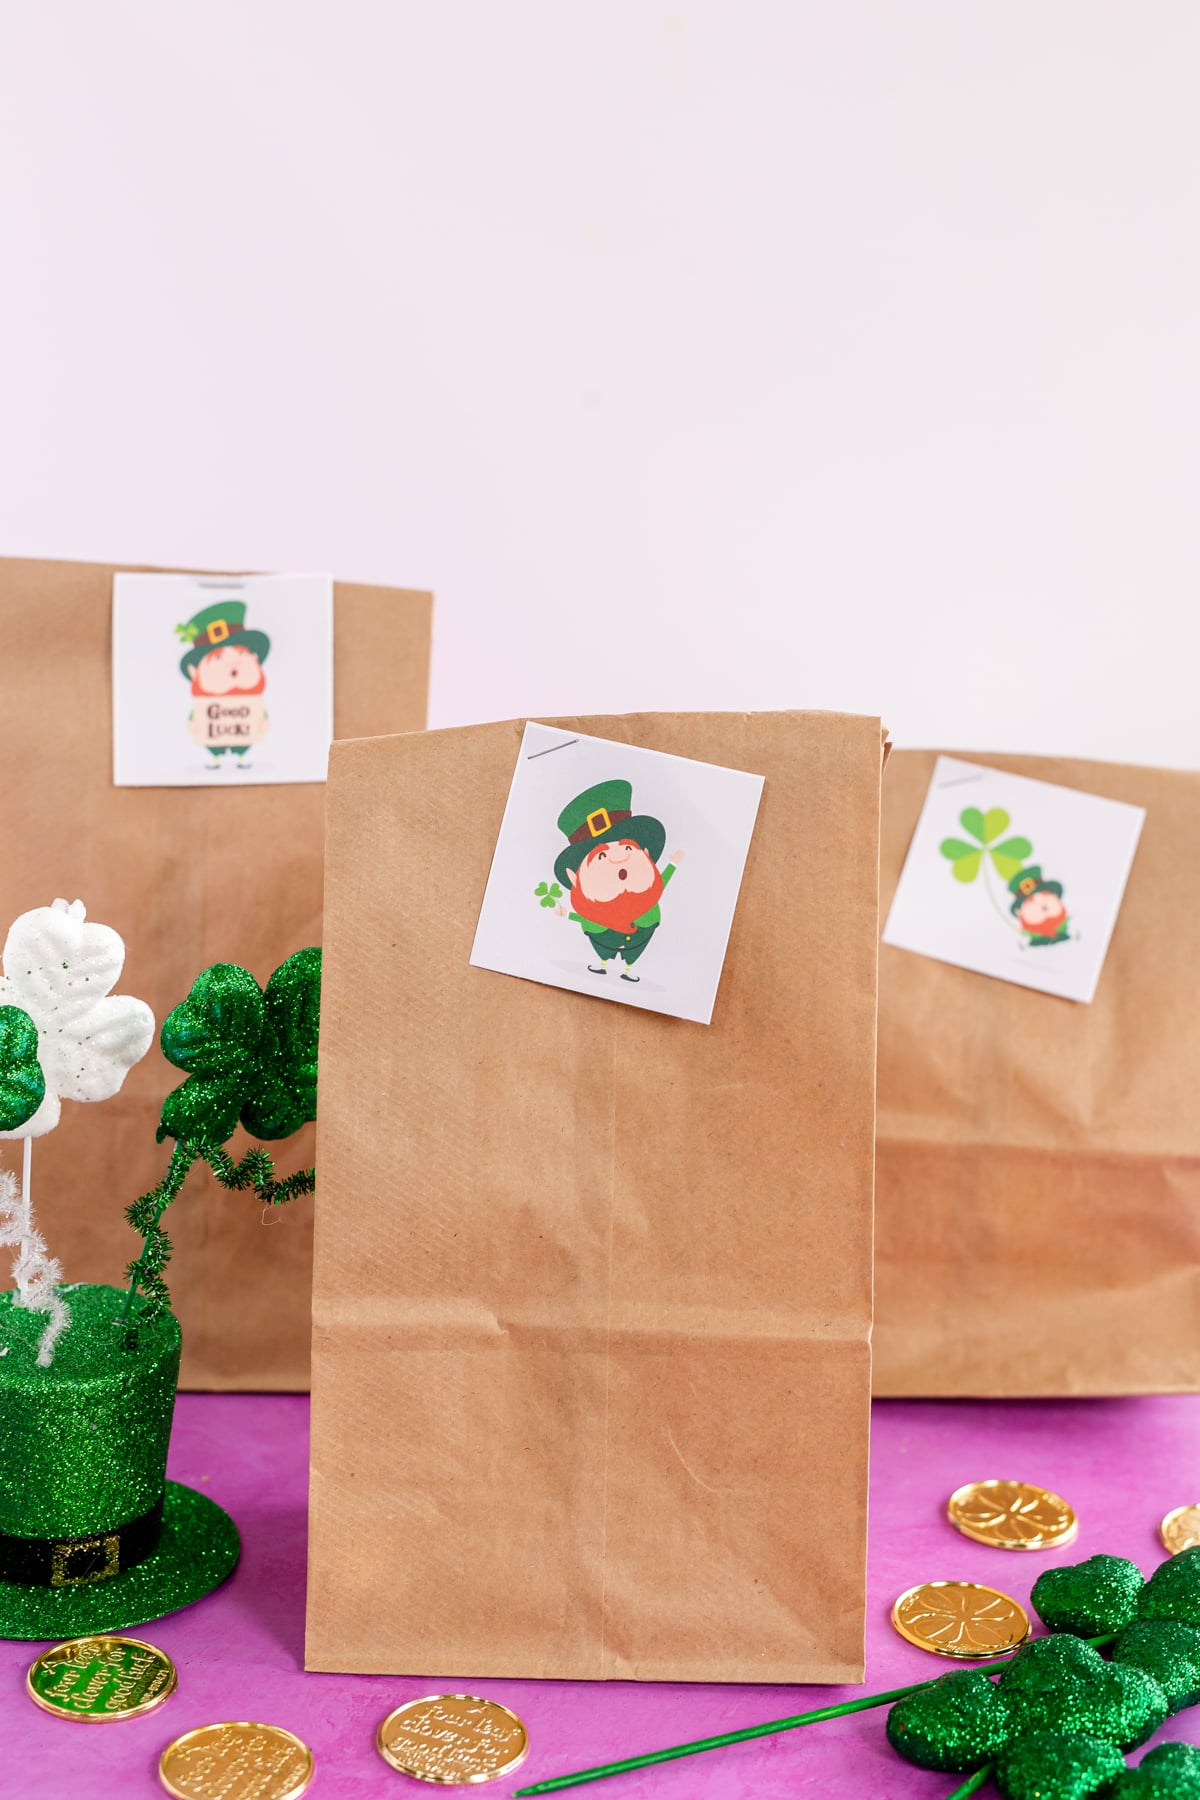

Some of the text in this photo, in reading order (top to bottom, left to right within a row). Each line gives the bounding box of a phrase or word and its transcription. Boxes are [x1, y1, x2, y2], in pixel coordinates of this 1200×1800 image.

[44, 1670, 80, 1702] four
[71, 1669, 112, 1709] clover
[105, 1677, 136, 1710] good
[400, 1717, 470, 1745] clover
[415, 1705, 472, 1727] four
